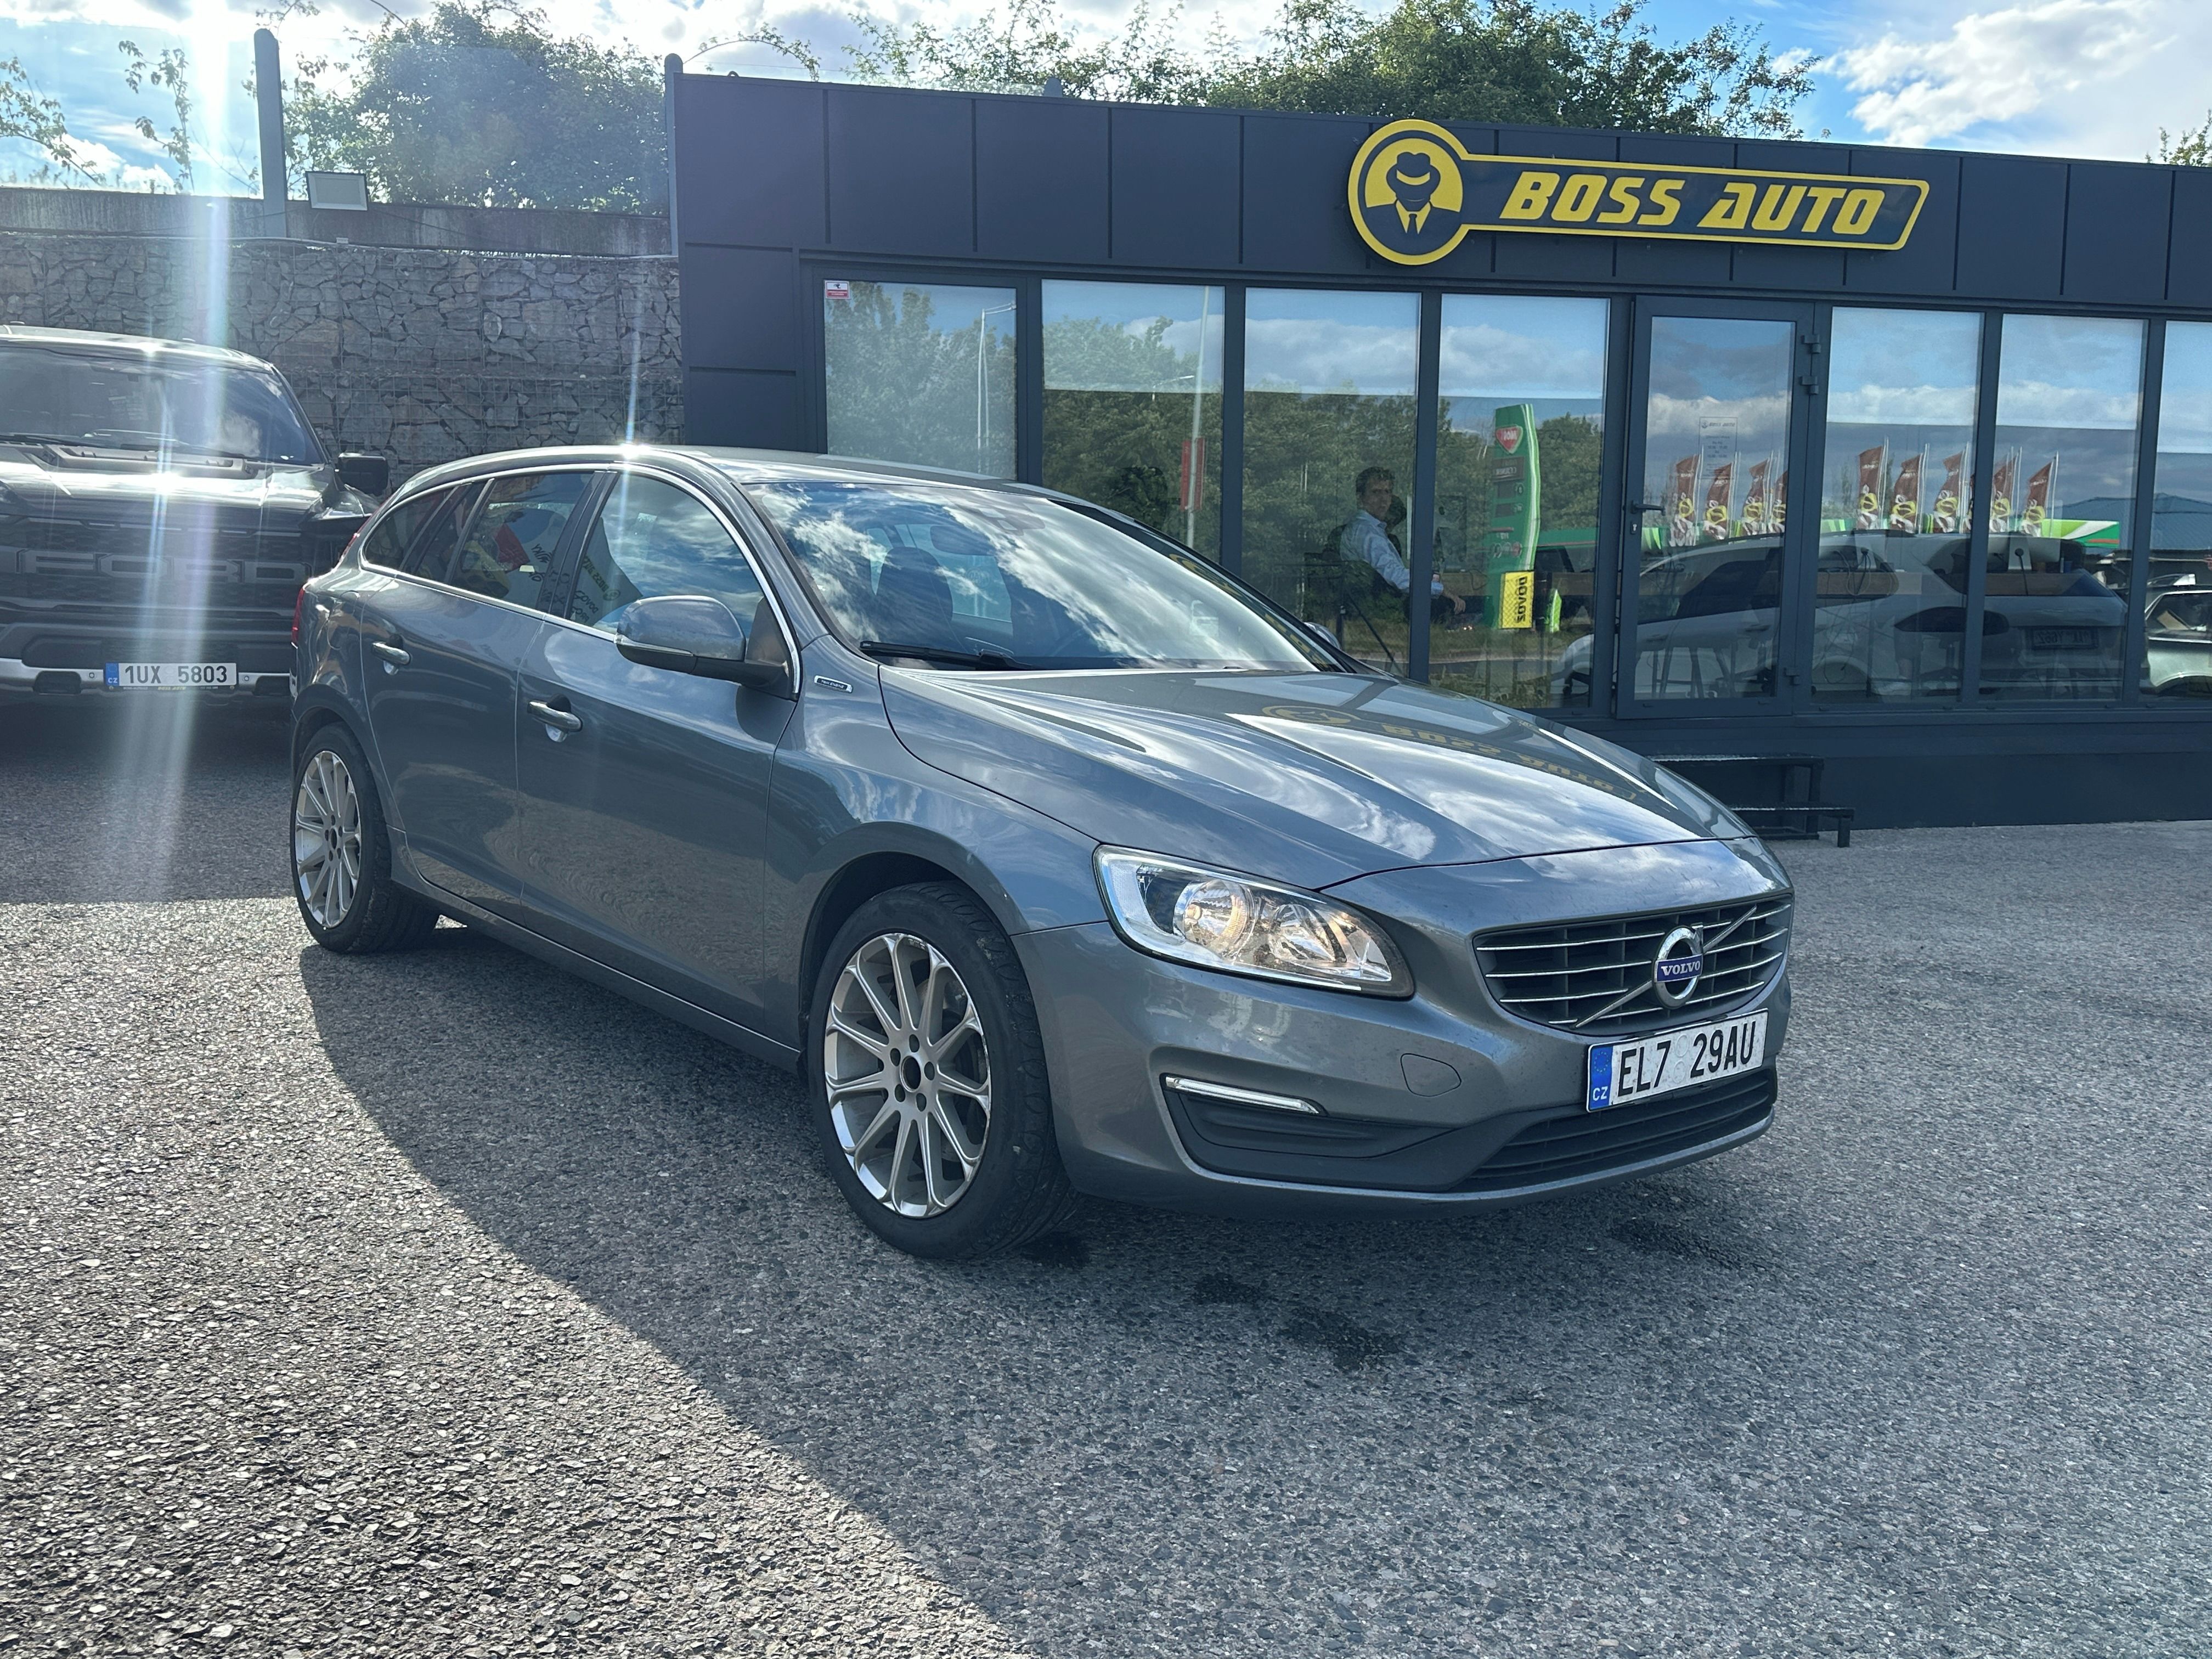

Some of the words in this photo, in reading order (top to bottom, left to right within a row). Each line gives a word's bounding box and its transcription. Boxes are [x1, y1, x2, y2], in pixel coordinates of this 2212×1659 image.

[1500, 172, 1685, 226] BOSS
[1697, 182, 1885, 235] AUTO
[125, 665, 161, 684] 1UX
[178, 665, 227, 683] 5803
[1661, 961, 1700, 976] VOLVO
[1618, 1040, 1671, 1097] EL7
[1690, 1021, 1756, 1079] 29AU
[1593, 1086, 1608, 1101] CZ
